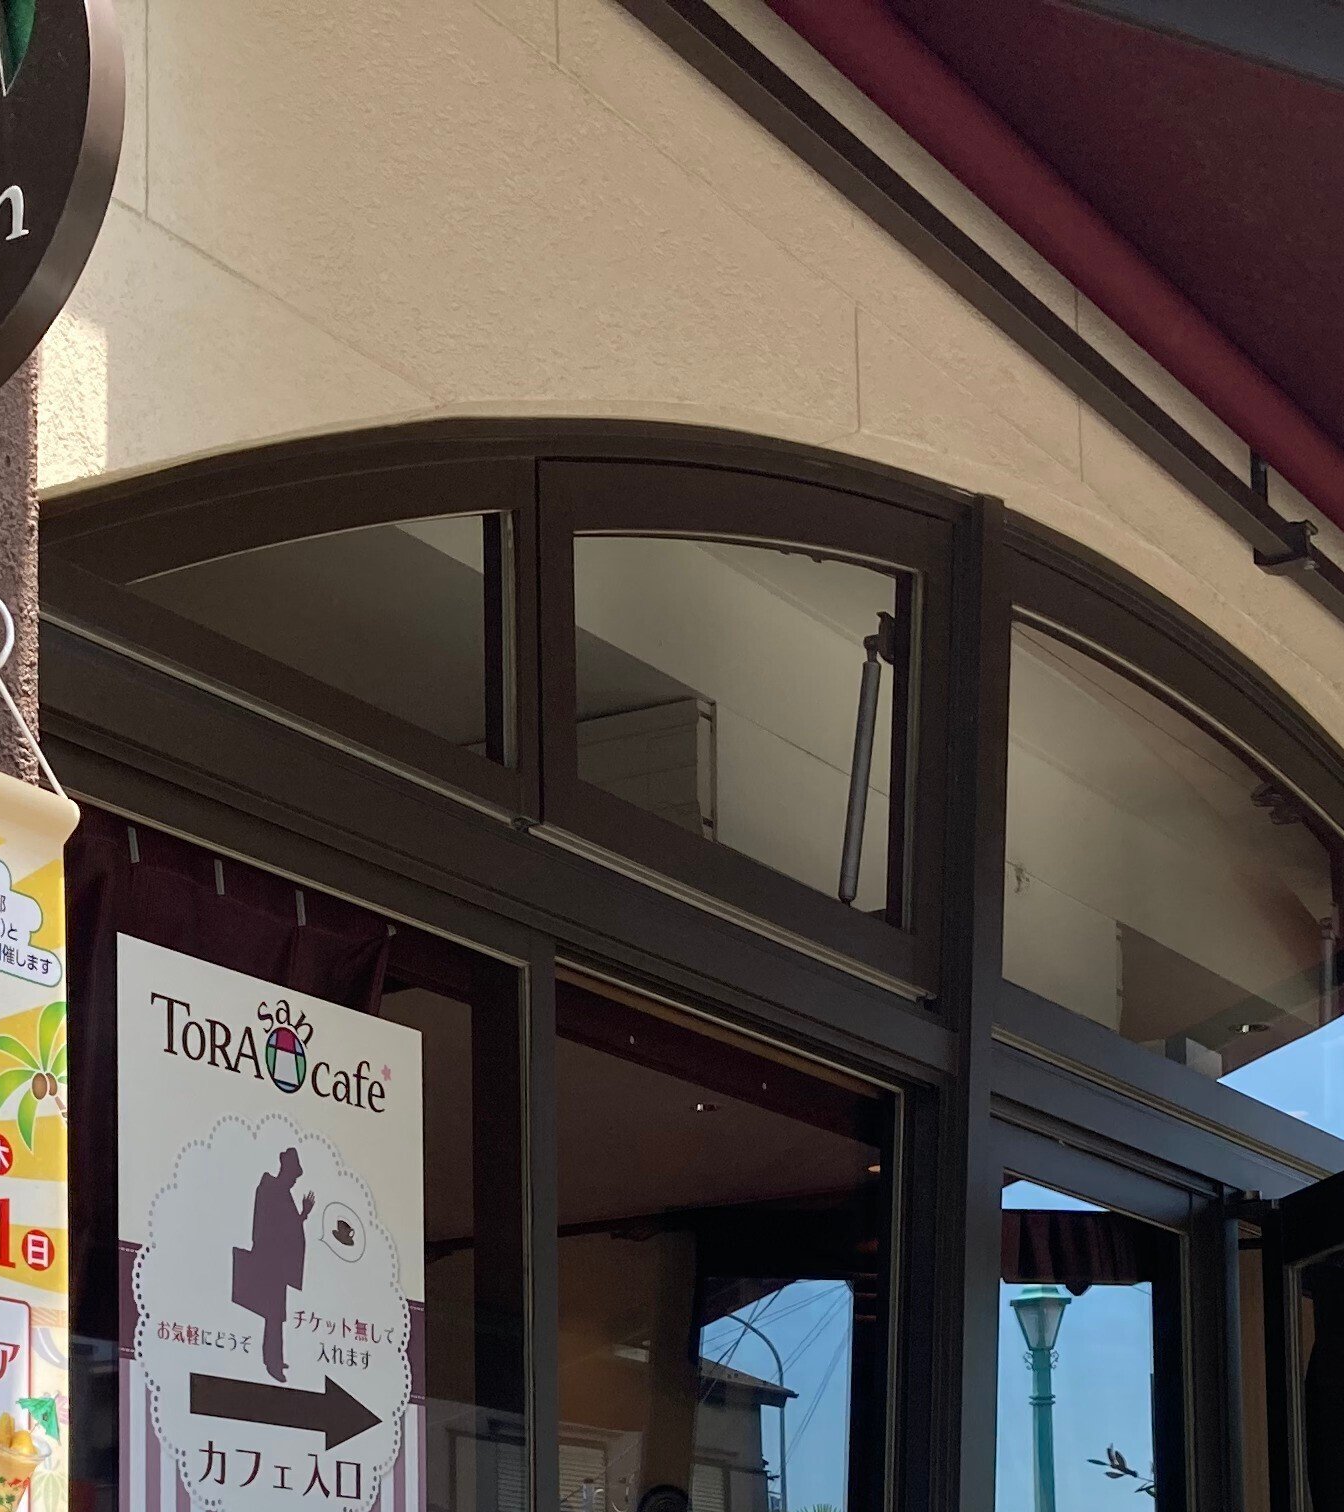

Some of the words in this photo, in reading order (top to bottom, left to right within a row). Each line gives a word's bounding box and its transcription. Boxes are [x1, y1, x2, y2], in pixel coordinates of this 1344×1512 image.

[310, 1060, 386, 1114] cafe
[156, 1320, 253, 1355] お気軽にどうぞ
[293, 1308, 396, 1346] チケット無しで
[316, 1343, 372, 1371] 入れます
[197, 1440, 362, 1501] カフェ入口
